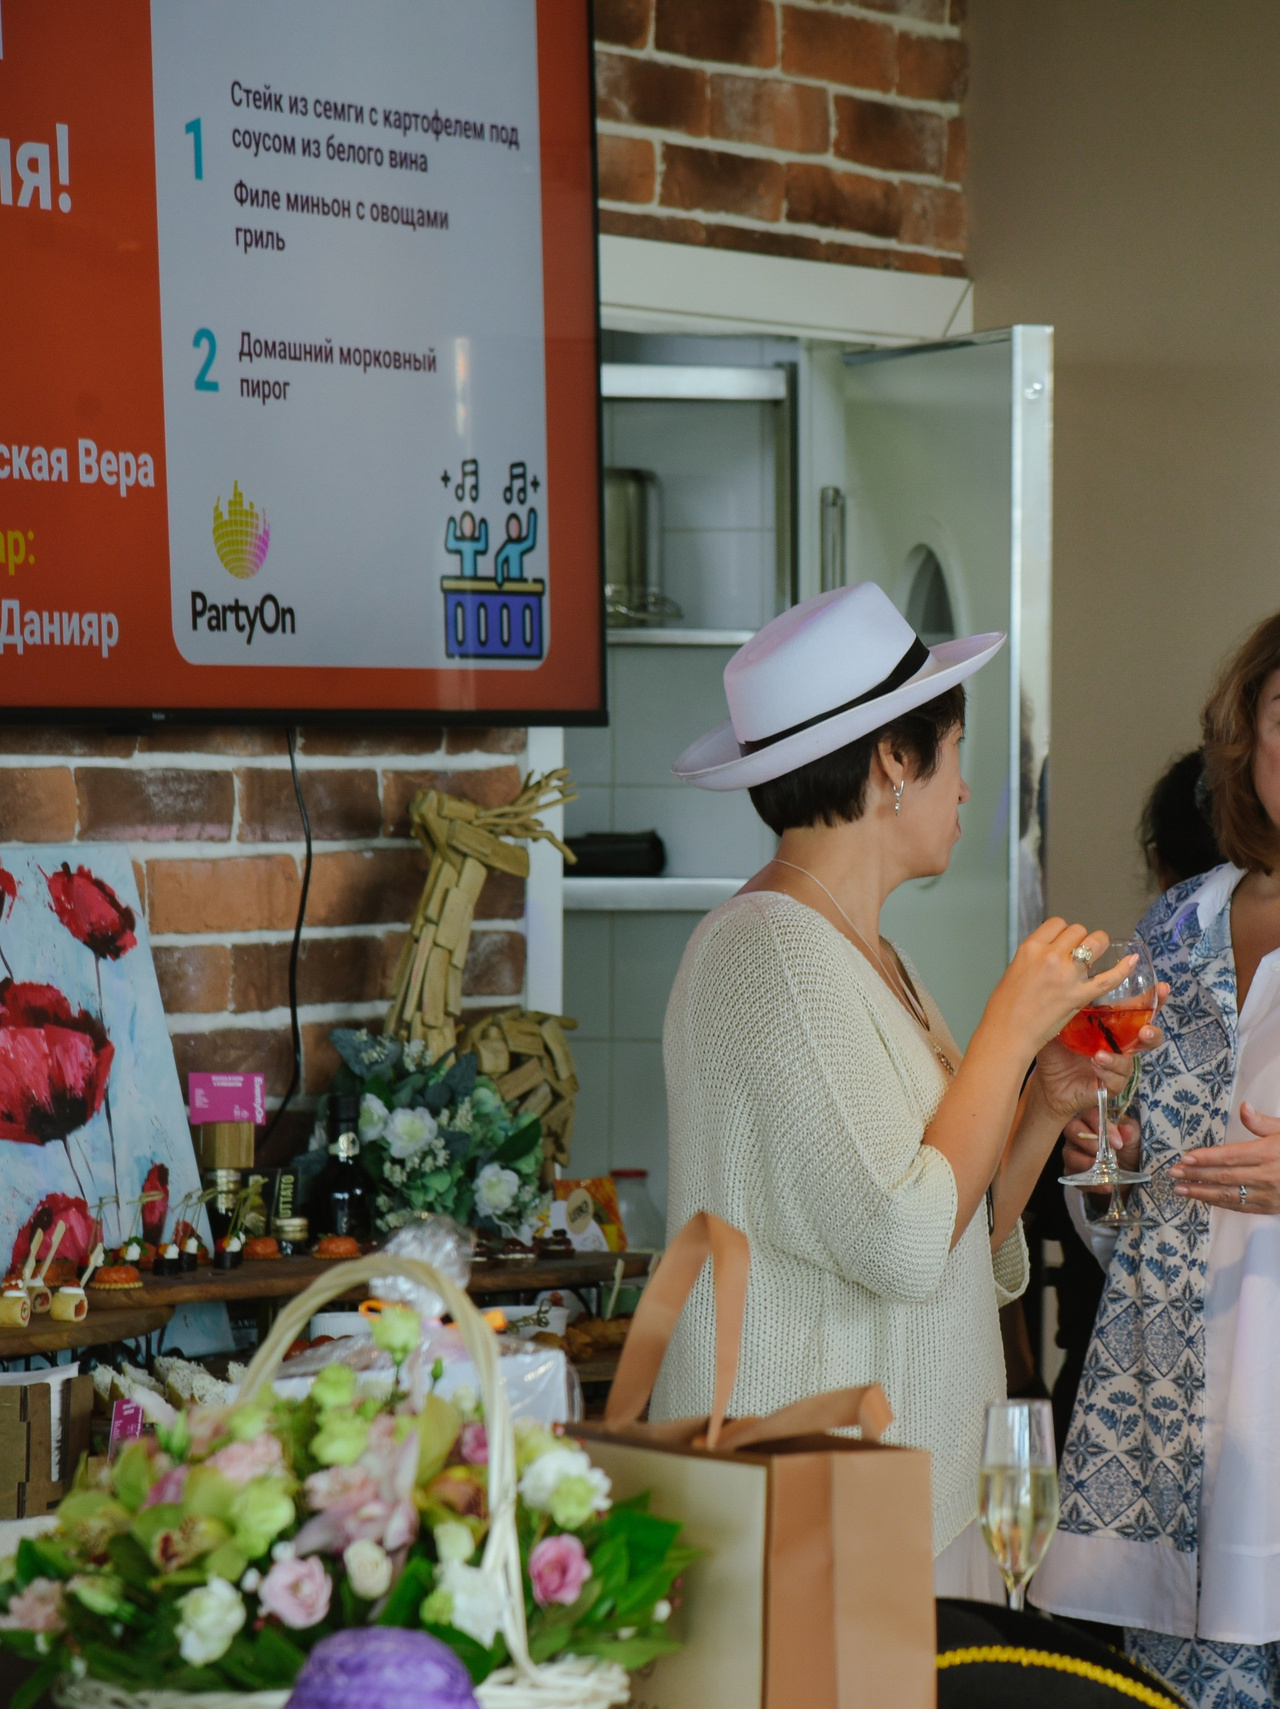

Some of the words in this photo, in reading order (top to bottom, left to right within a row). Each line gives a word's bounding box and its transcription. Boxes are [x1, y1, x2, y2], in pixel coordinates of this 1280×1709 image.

[230, 79, 284, 114] Стейк
[288, 94, 309, 117] из
[312, 98, 365, 125] семги
[368, 106, 379, 127] с
[382, 108, 486, 142] картофелем
[489, 123, 521, 151] под
[185, 117, 204, 180] 1
[231, 127, 297, 158] соусом
[300, 137, 322, 159] из
[325, 133, 385, 168] белого
[388, 149, 429, 174] вина
[233, 178, 281, 211] Филе
[285, 192, 352, 219] миньон
[355, 200, 366, 221] с
[369, 202, 450, 232] овощами
[234, 226, 286, 255] гриль
[193, 328, 219, 392] 2
[238, 330, 334, 365] Домашний
[338, 345, 437, 374] морковный
[239, 377, 291, 407] пирог
[78, 438, 156, 498] Вера
[0, 599, 119, 658] Данияр
[191, 591, 295, 644] PartyOn
